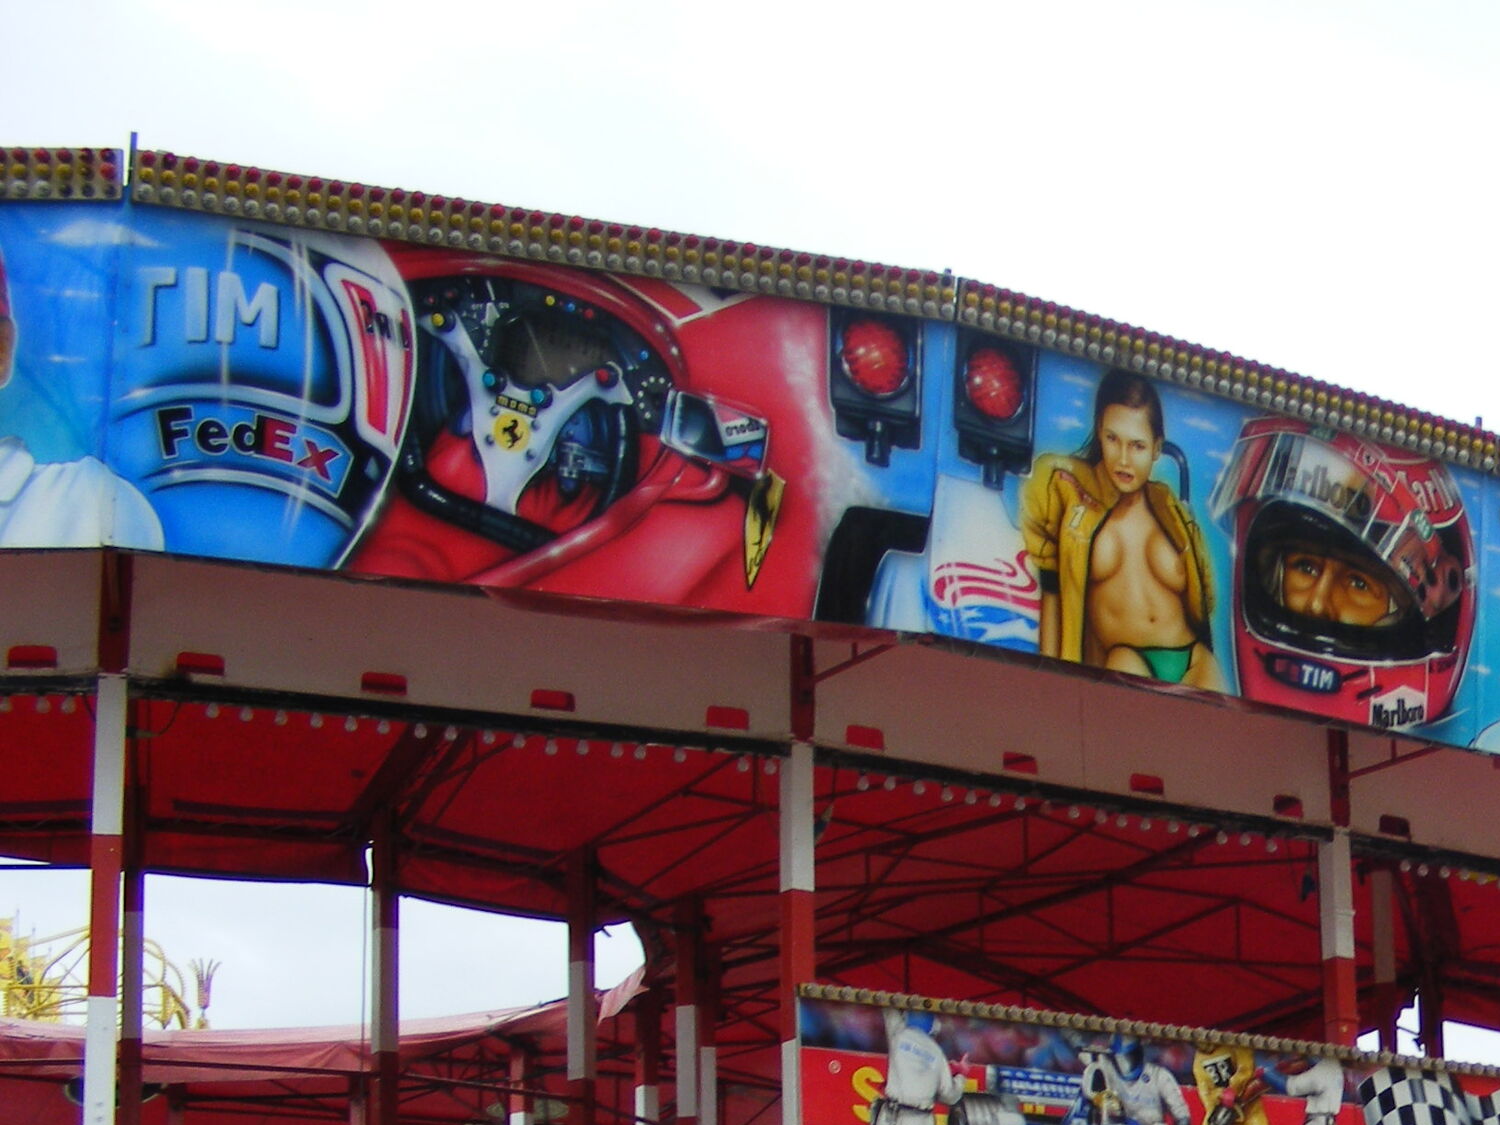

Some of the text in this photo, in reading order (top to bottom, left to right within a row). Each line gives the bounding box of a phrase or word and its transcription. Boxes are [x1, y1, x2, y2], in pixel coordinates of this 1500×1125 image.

[139, 266, 280, 350] TIM
[1301, 664, 1335, 690] TIM
[1372, 698, 1425, 728] Marlboro
